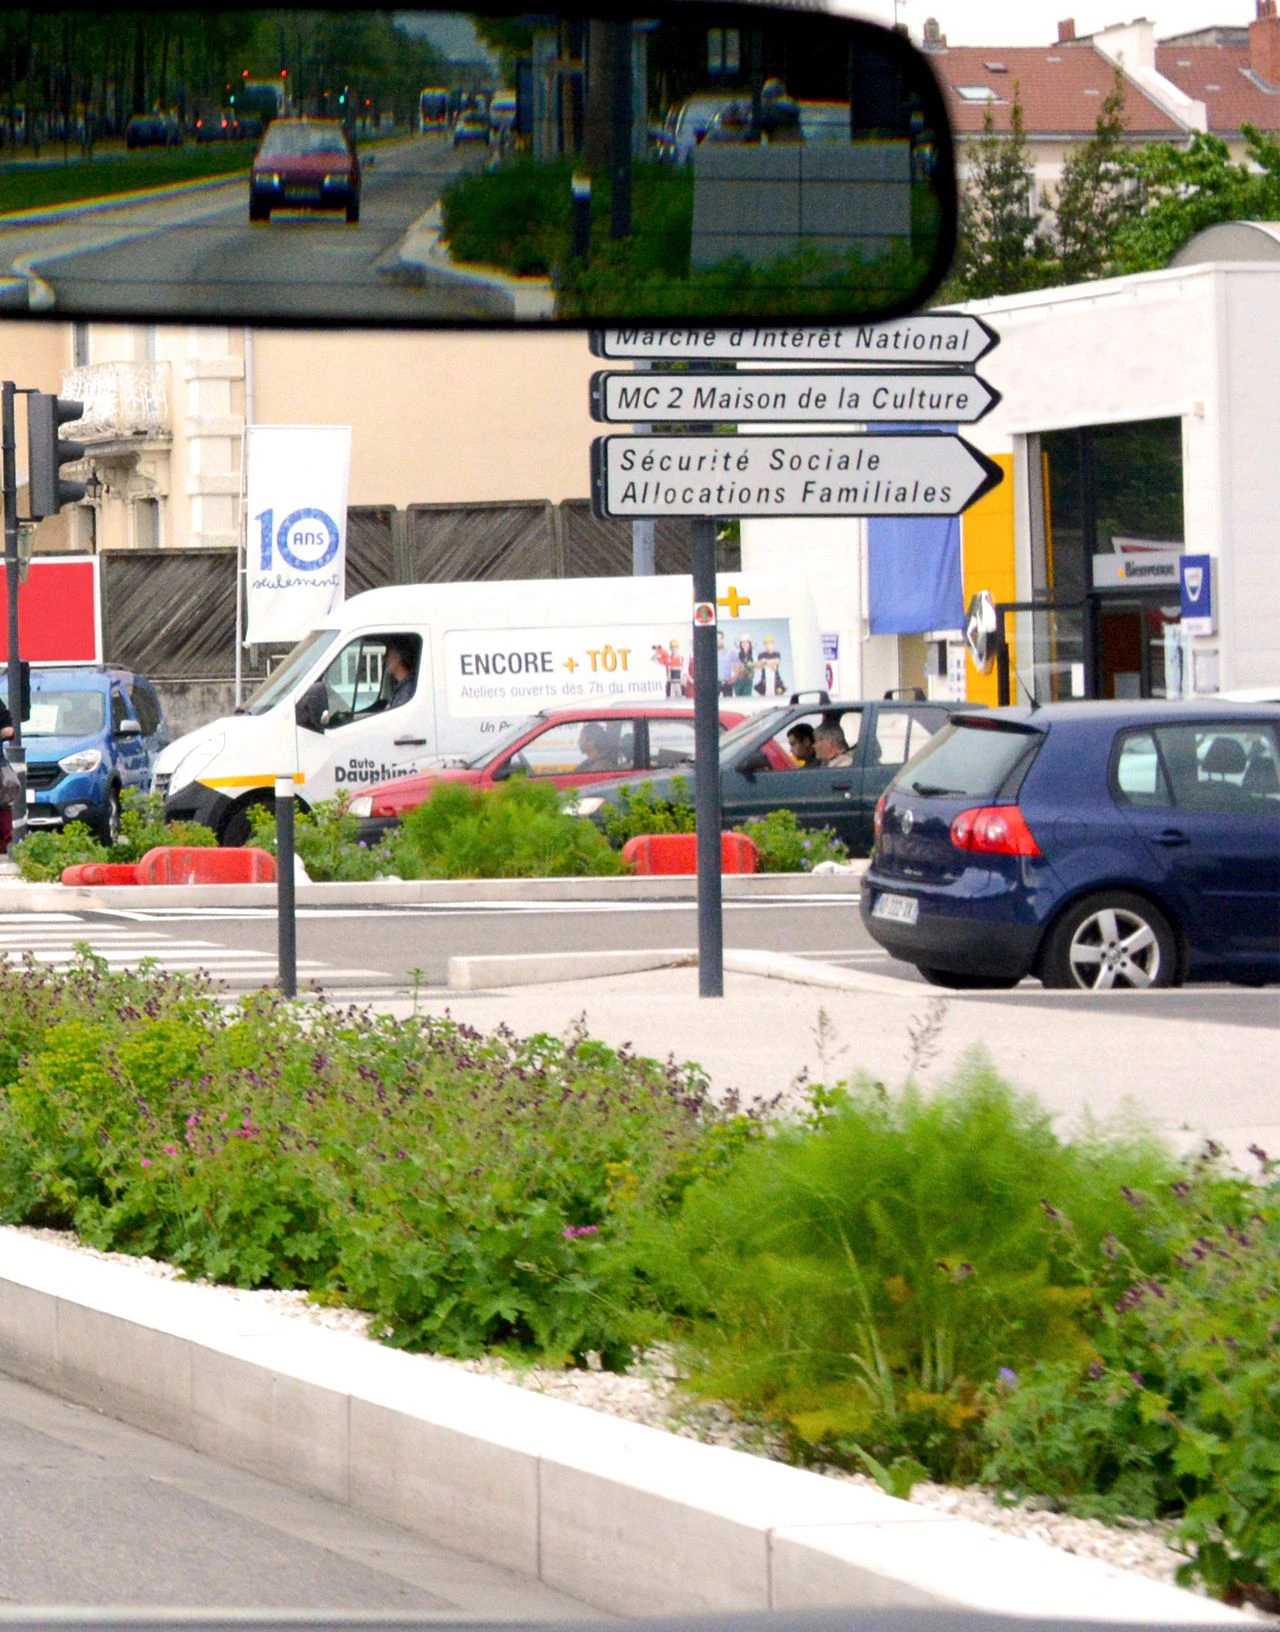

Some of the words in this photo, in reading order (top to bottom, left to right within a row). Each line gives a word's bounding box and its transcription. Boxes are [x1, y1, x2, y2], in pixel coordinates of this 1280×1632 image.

[856, 326, 971, 351] National
[618, 387, 661, 409] MC
[667, 387, 684, 409] 2
[693, 387, 788, 409] Maison
[798, 387, 828, 409] de
[838, 387, 860, 410] la
[872, 387, 970, 411] Culture
[620, 448, 750, 472] Sécurité
[770, 448, 881, 472] Sociale
[620, 481, 786, 504] Allocations
[801, 480, 952, 504] Familiales
[254, 507, 340, 571] 10
[252, 573, 340, 590] seulement
[460, 651, 554, 676] ENCORE
[586, 644, 631, 672] TÔT
[460, 684, 506, 699] Ateliers
[510, 683, 557, 697] ouverts
[562, 681, 584, 696] dès
[589, 681, 603, 694] 7h
[608, 679, 623, 693] du
[628, 679, 663, 693] matin
[335, 763, 419, 785] Dauphiné
[349, 758, 375, 769] auto
